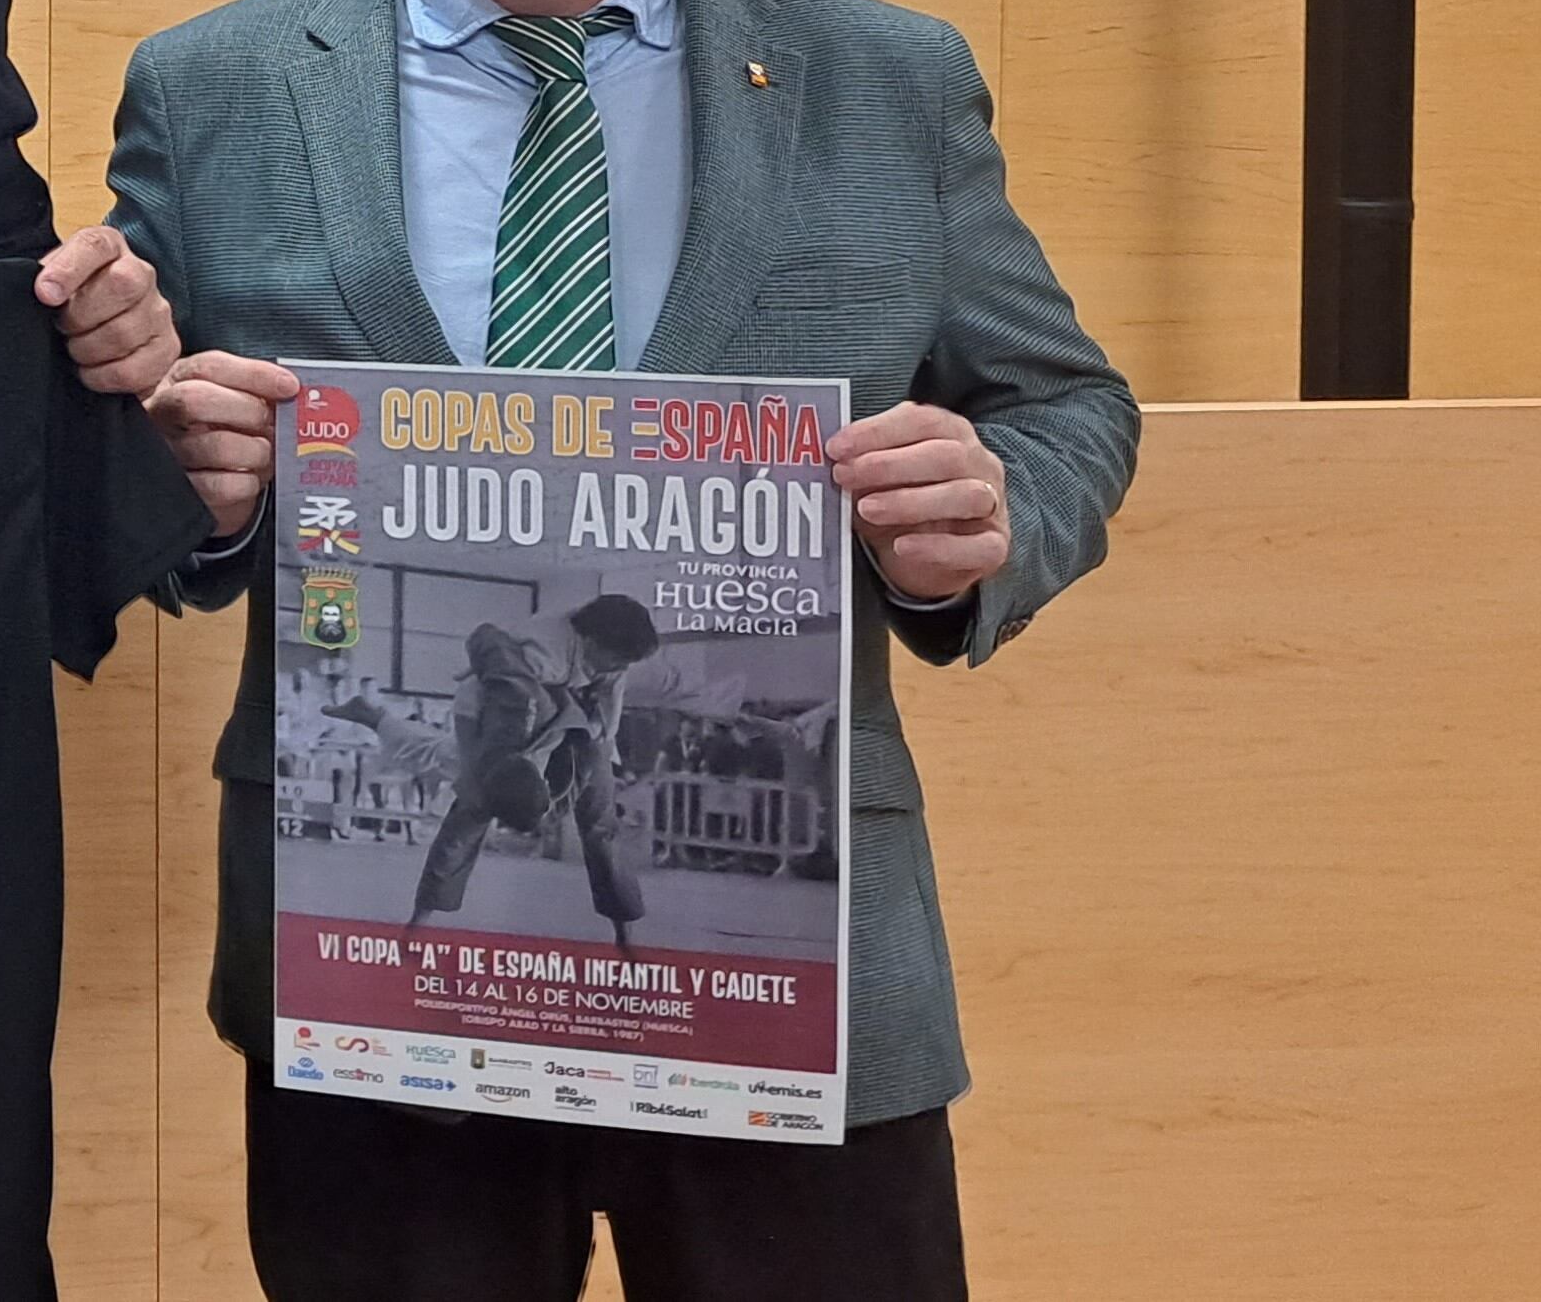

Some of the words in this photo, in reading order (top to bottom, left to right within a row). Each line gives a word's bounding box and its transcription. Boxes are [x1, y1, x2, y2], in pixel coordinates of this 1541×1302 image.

[299, 421, 349, 439] JUDO
[380, 387, 535, 455] COPAS
[552, 395, 615, 458] DE
[631, 394, 825, 466] ESPAÑA
[382, 464, 544, 546] JUDO
[568, 467, 824, 558] ARAGÓN
[678, 561, 698, 575] TU
[702, 562, 799, 580] PROVINCIA
[654, 580, 822, 616] Huesca
[280, 819, 304, 837] 12
[318, 933, 339, 960] VI
[347, 935, 401, 967] COPA
[459, 946, 485, 975] DE
[493, 949, 576, 984] ESPAÑA
[584, 958, 682, 994] INFANTIL
[690, 968, 705, 996] Y
[712, 970, 796, 1005] CADETE
[414, 976, 448, 995] DEL
[455, 979, 478, 997] 14
[483, 982, 507, 1001] AL
[515, 985, 537, 1004] 16
[544, 988, 570, 1006] DE
[575, 991, 694, 1019] NOVIEMBRE
[414, 999, 498, 1015] POLIDEPORTIVO
[543, 1061, 585, 1078] Jaca
[400, 1074, 444, 1091] asisa
[475, 1083, 530, 1099] amazon
